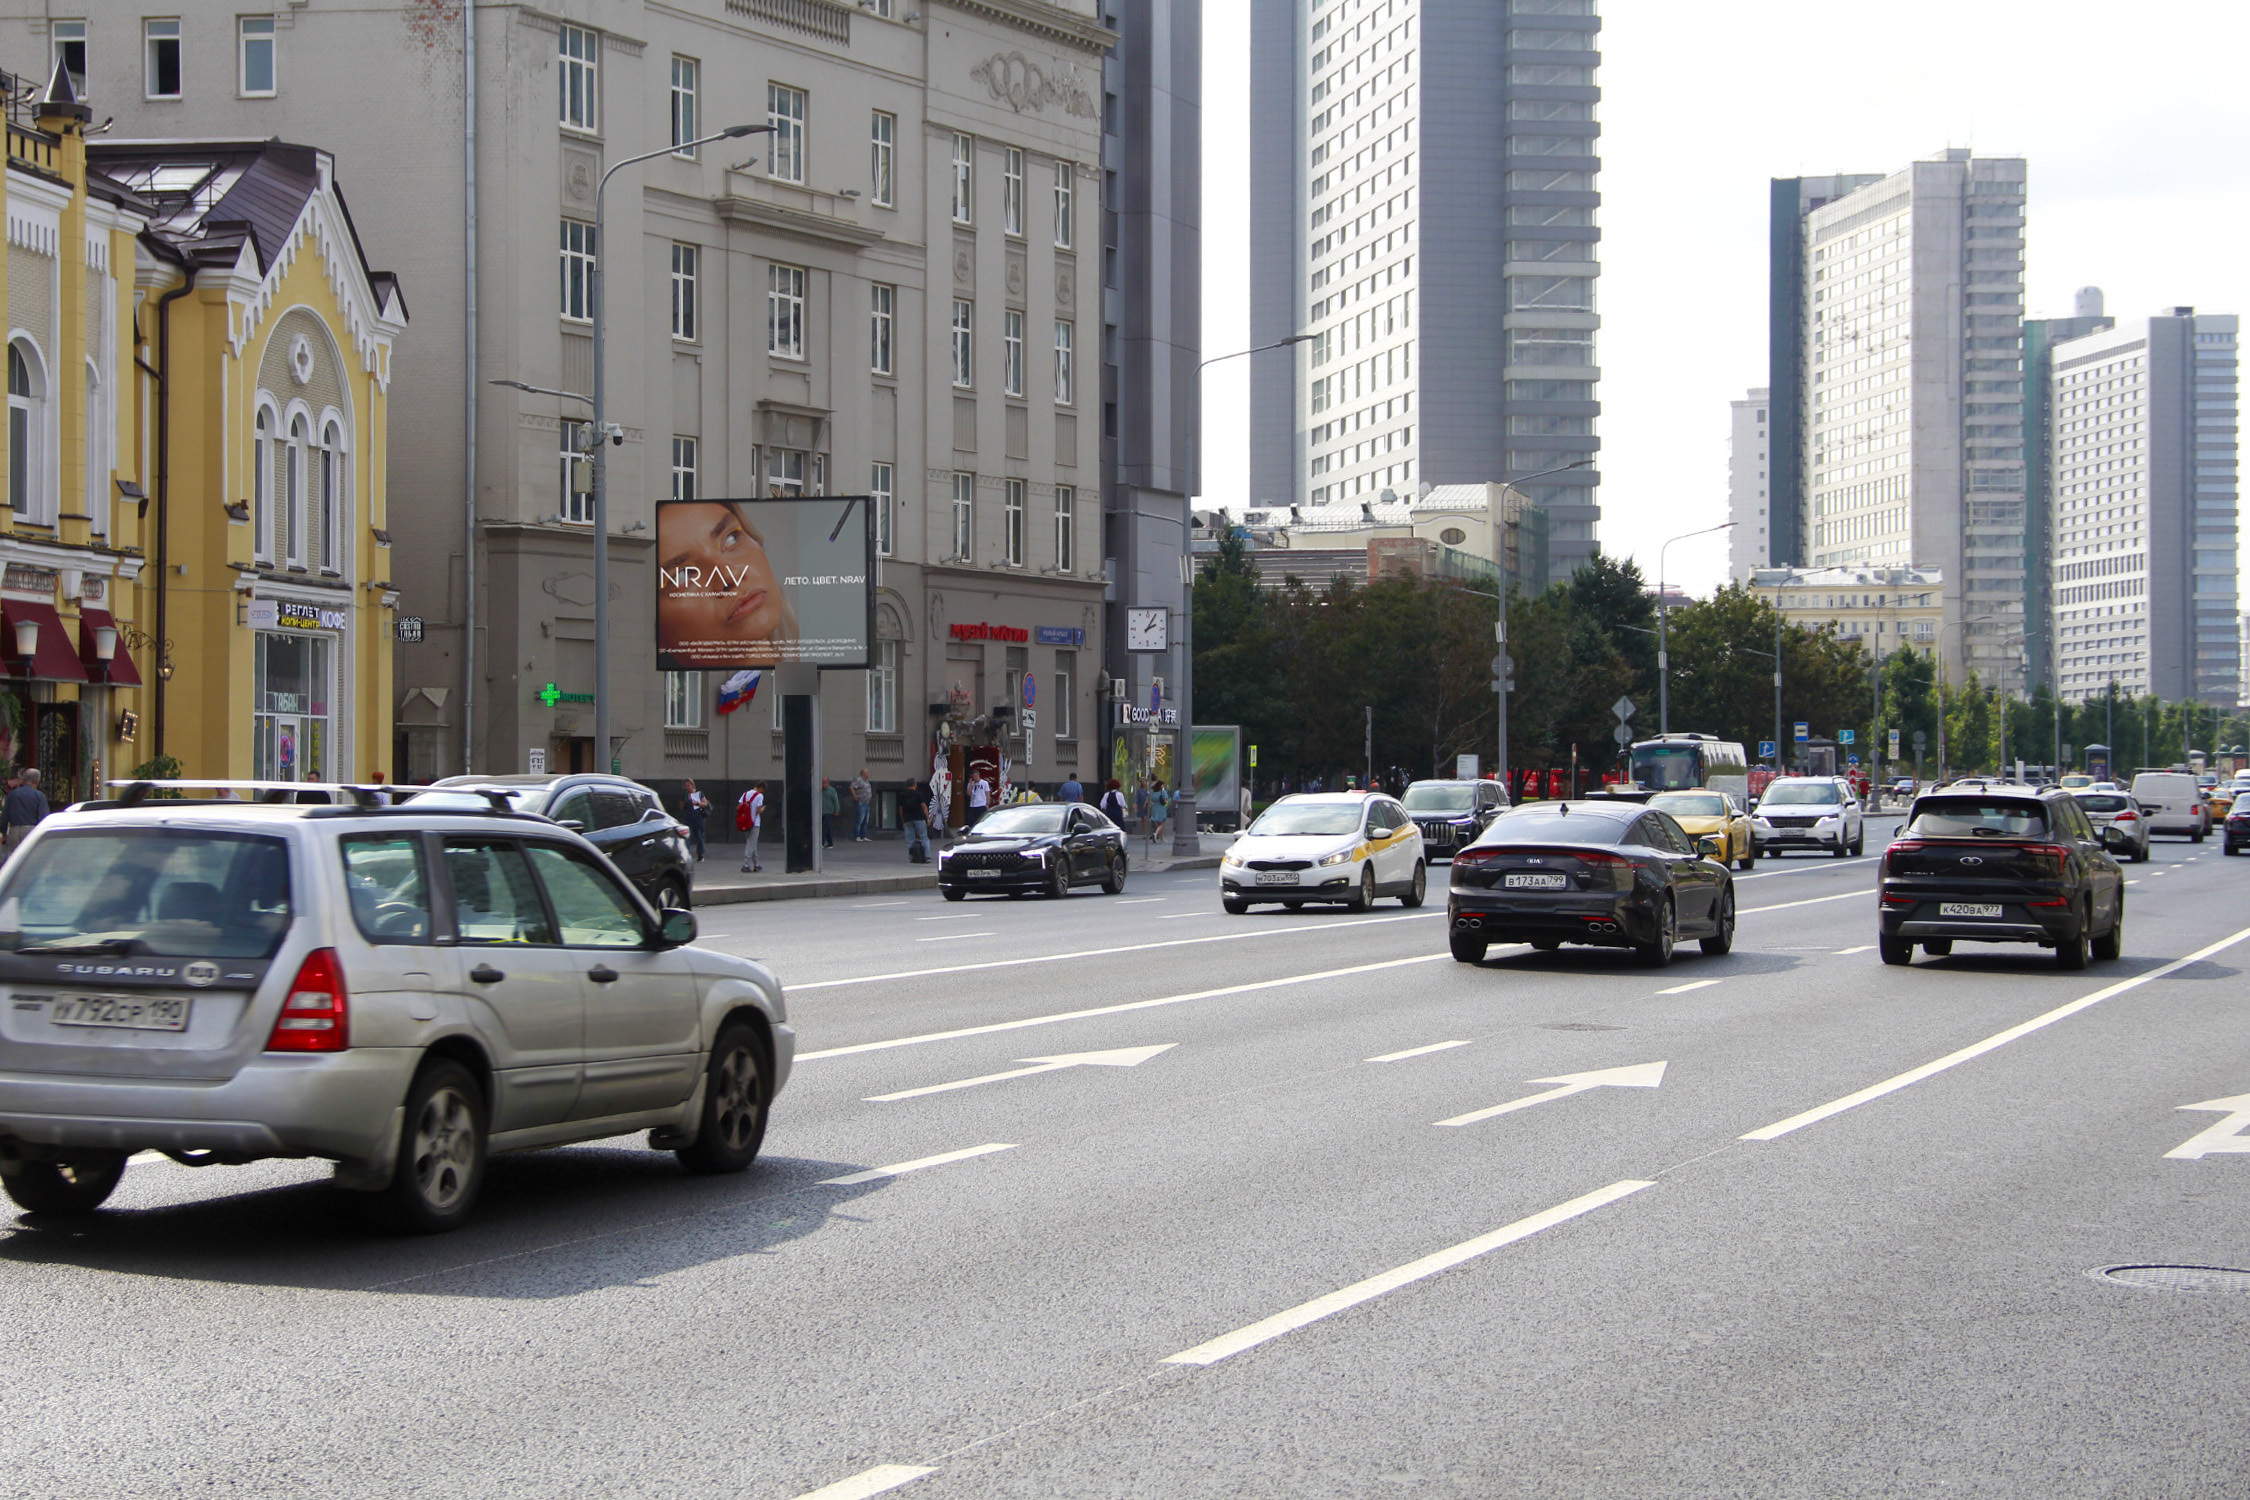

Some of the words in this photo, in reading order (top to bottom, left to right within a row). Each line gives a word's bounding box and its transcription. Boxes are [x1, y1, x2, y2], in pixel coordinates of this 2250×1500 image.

[660, 565, 749, 588] NRAV
[784, 576, 811, 586] ЛЕТО.
[812, 576, 838, 586] ЦВЕТ.
[840, 575, 866, 584] NRAV
[285, 603, 320, 618] РЕГЛЕТ
[281, 617, 321, 629] КОПИ-ЦЕНТР
[321, 610, 346, 630] КОФЕ
[950, 622, 989, 641] МУЗЕЙ
[990, 625, 1029, 642] МАГИИ
[1132, 707, 1150, 722] GOOD
[1508, 876, 1547, 886] В173АА
[1548, 875, 1564, 883] 799
[1943, 904, 1982, 915] К420ВА
[1984, 905, 1999, 913] 977
[57, 963, 176, 977] SUBARU
[149, 1000, 183, 1019] 190
